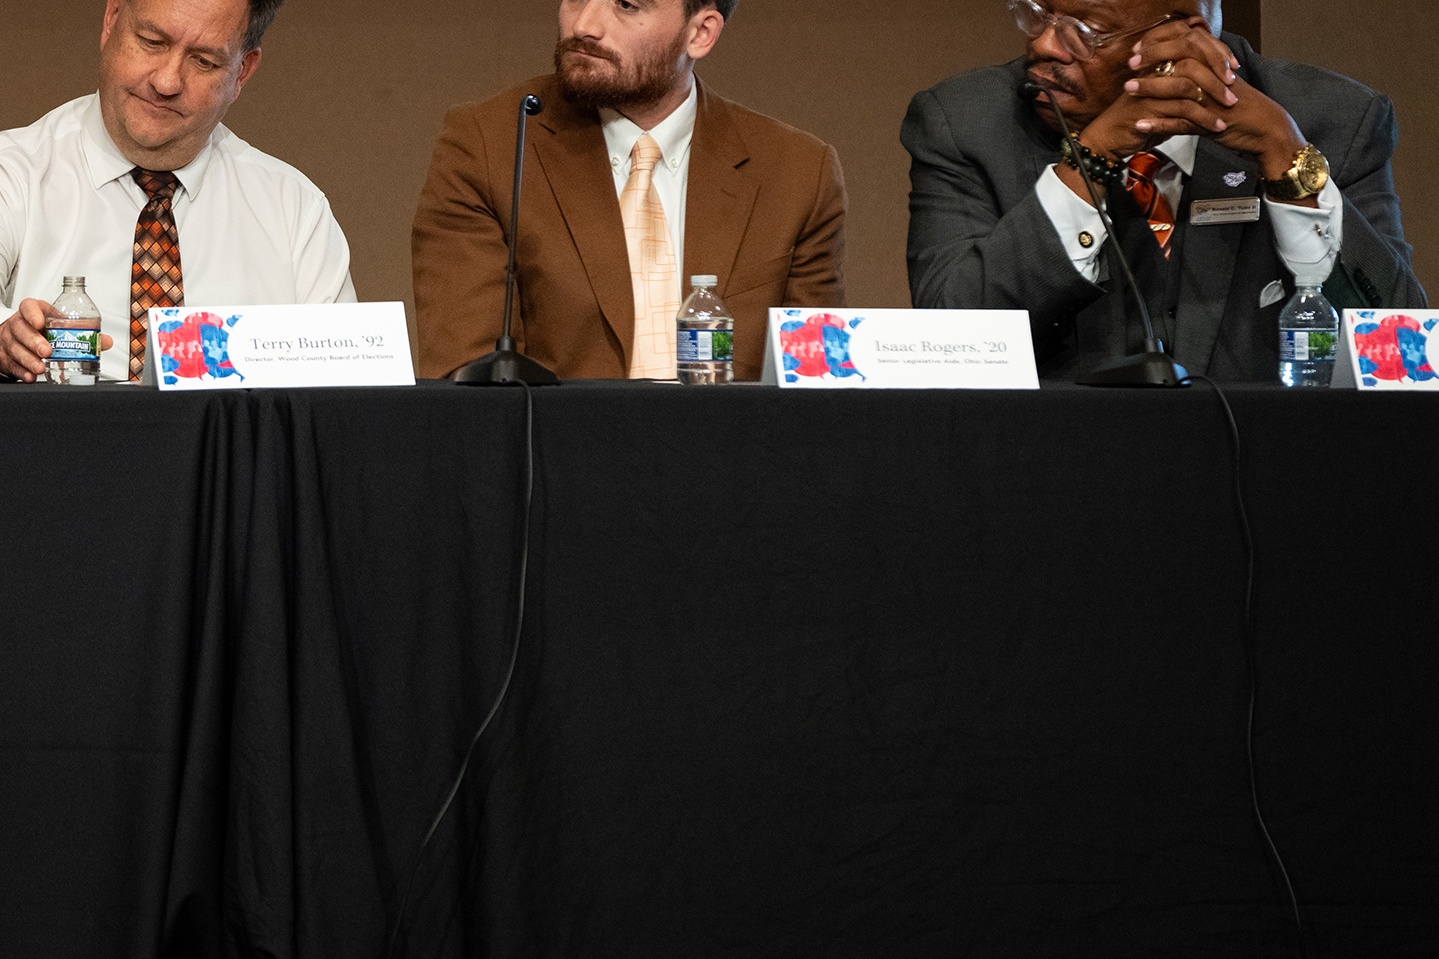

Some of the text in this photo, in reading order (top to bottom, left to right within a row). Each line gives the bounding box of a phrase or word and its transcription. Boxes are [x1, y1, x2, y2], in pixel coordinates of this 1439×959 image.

[55, 341, 89, 350] MOUNTAIN
[250, 338, 293, 353] Terry
[298, 337, 358, 349] Burton,
[875, 340, 917, 352] Isaac
[921, 340, 980, 356] Rogers,
